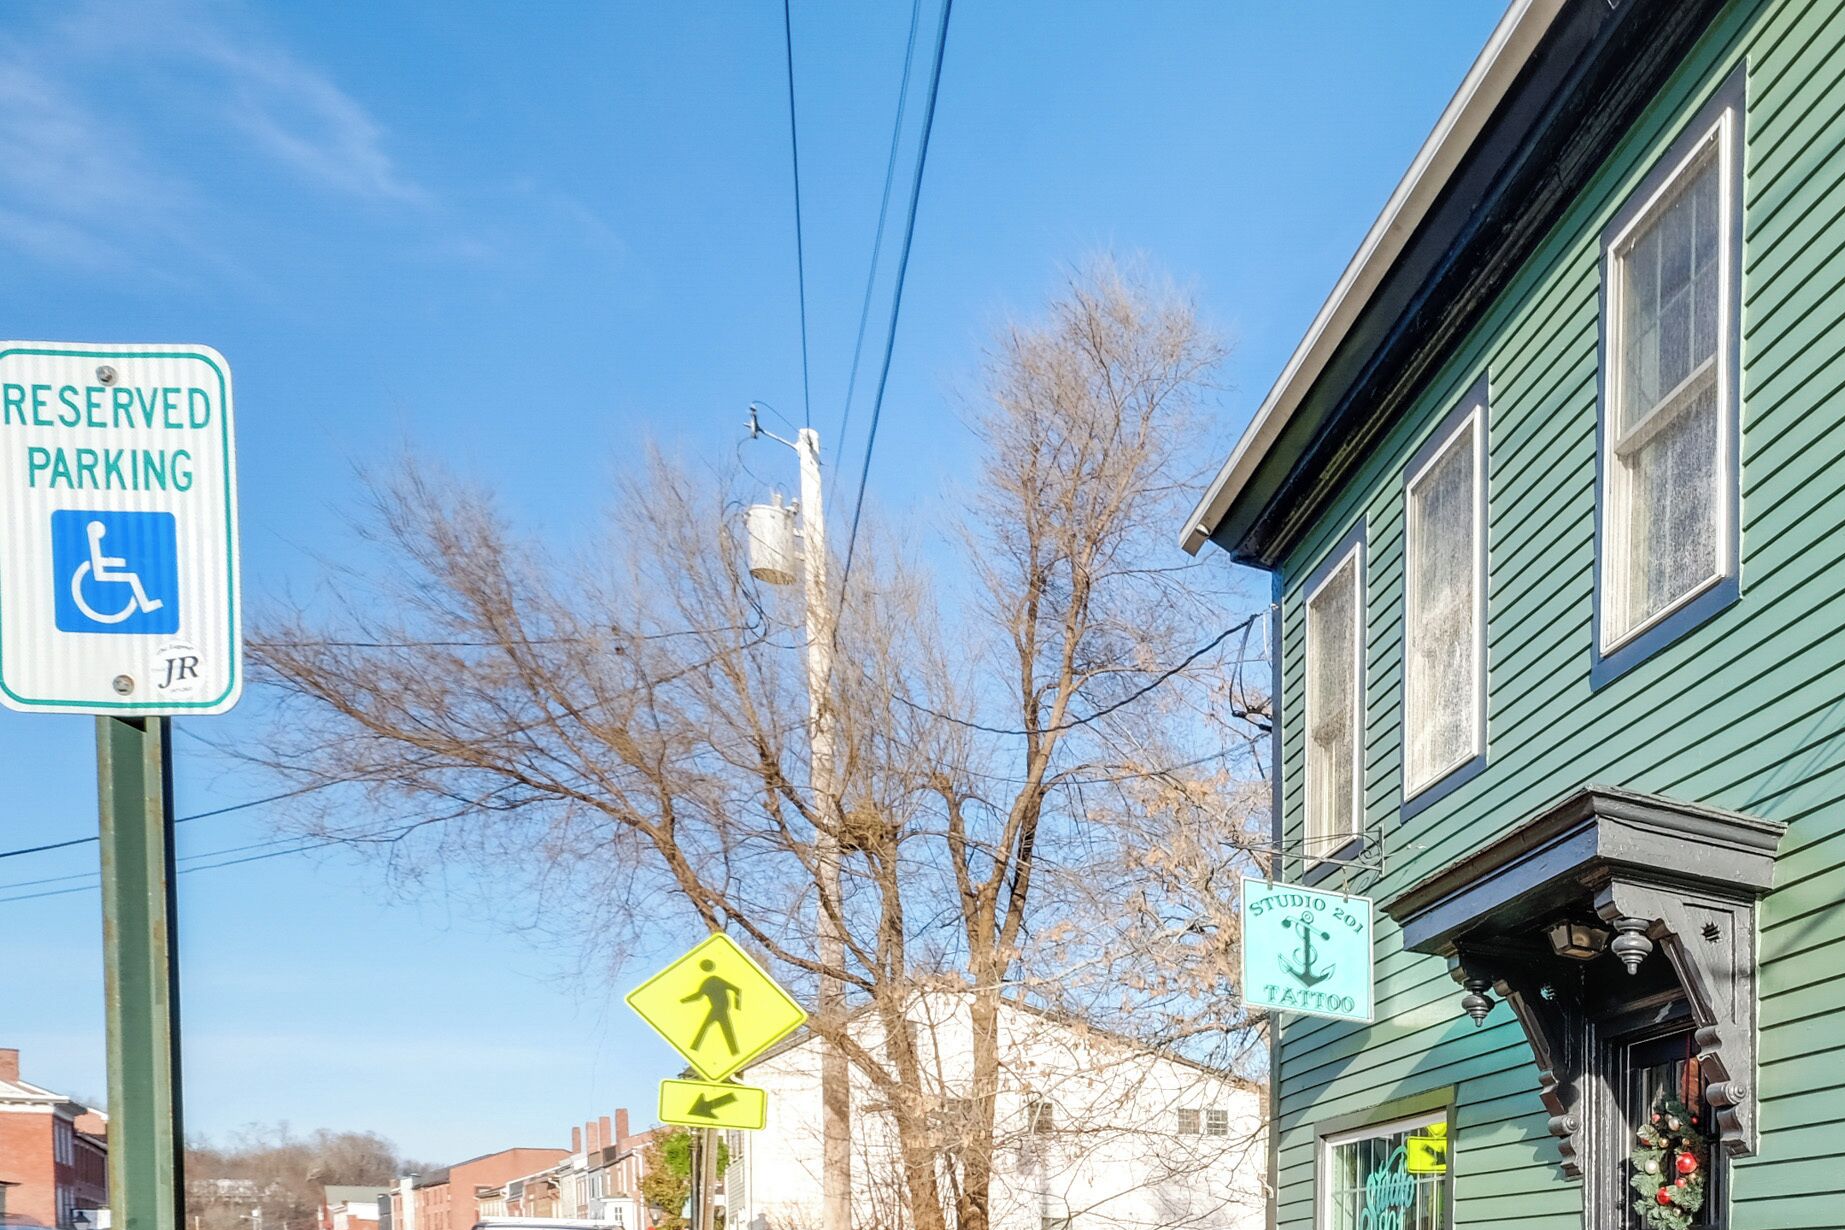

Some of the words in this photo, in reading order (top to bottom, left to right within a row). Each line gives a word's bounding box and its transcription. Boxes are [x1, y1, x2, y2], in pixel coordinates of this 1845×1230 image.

[3, 383, 211, 429] RESERVED
[28, 446, 193, 492] PARKING
[158, 655, 199, 689] JR
[1249, 894, 1326, 917] STUDIO
[1332, 907, 1364, 935] 201
[1264, 984, 1355, 1013] TATTOO
